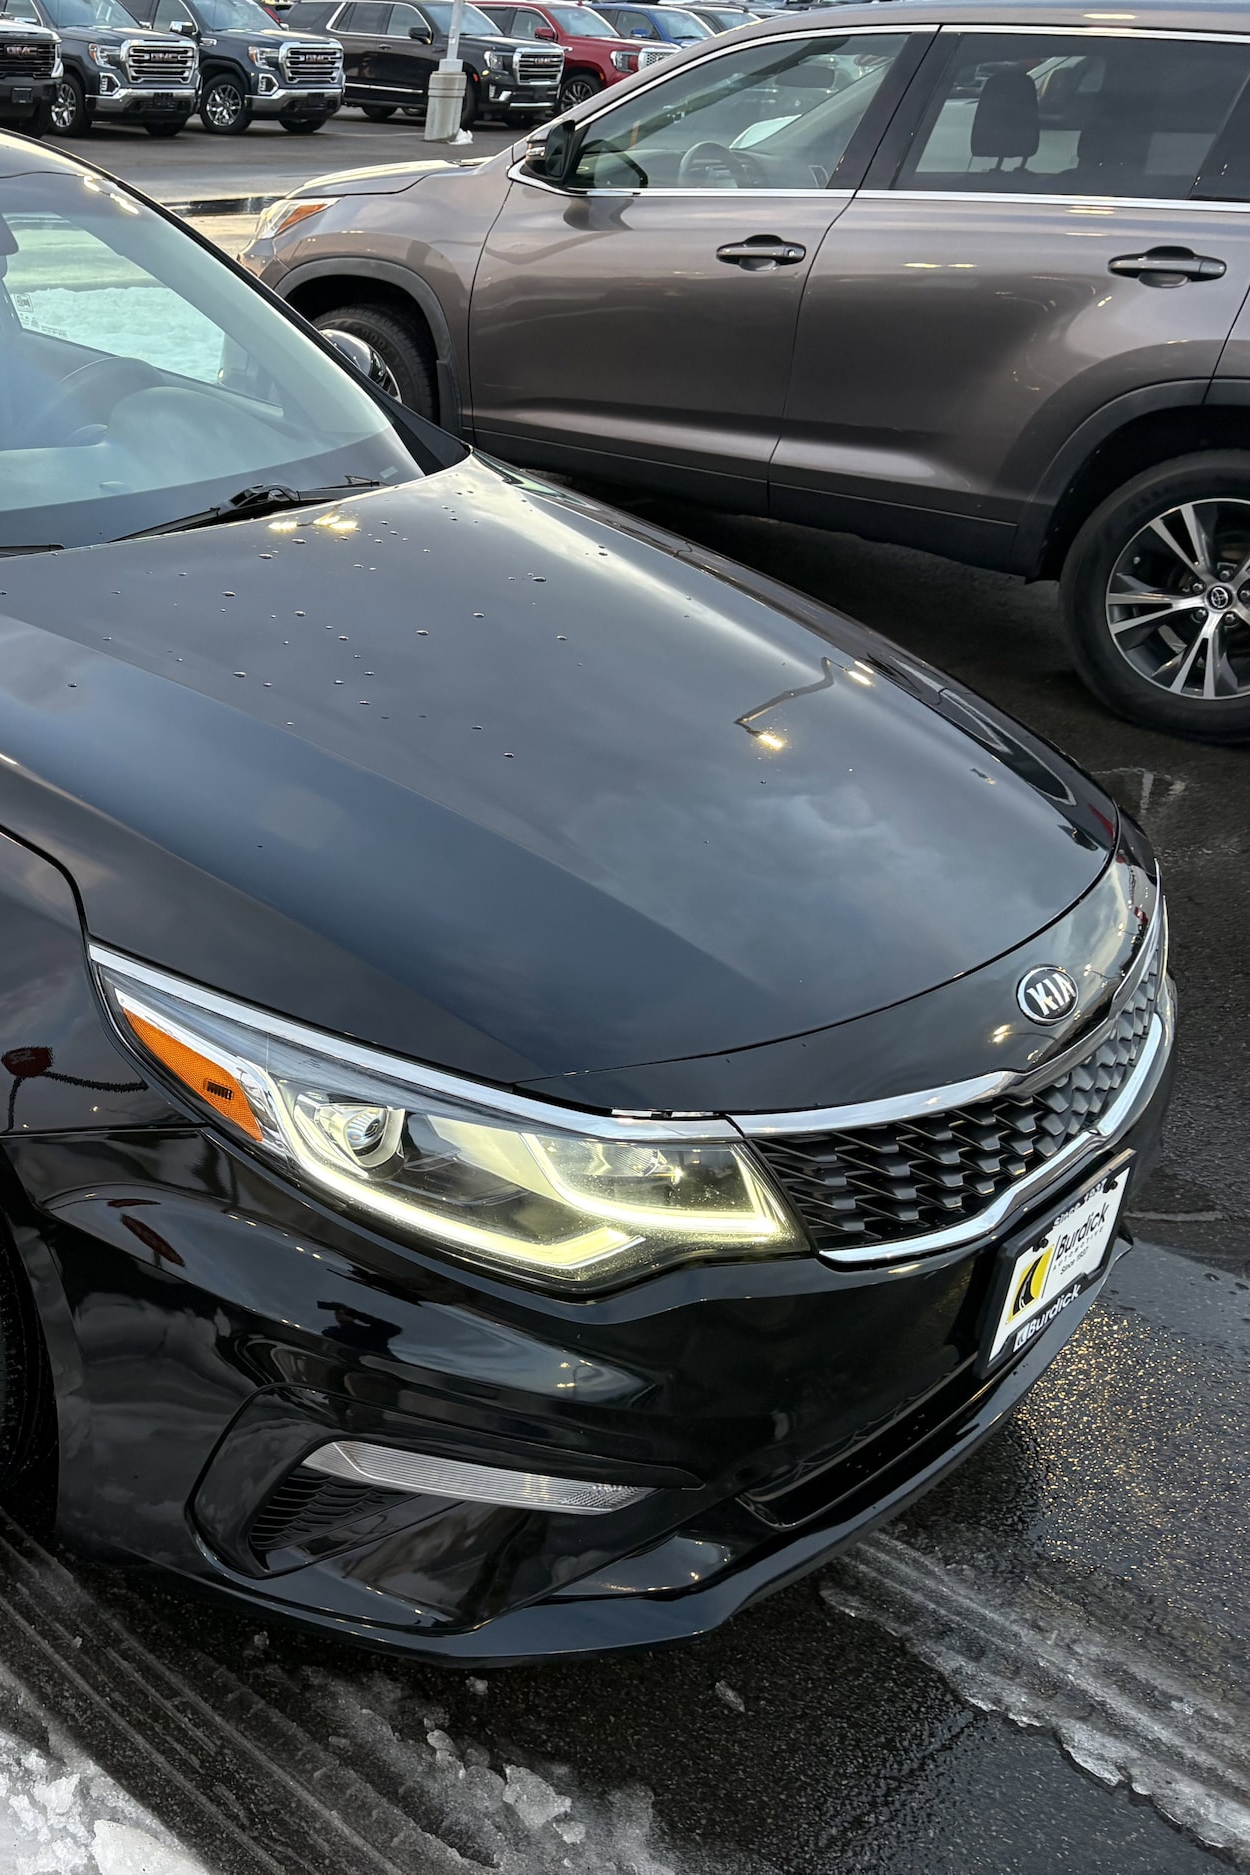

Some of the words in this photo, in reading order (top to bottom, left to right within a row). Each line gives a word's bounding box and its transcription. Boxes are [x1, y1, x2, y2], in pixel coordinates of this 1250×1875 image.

[6, 46, 37, 56] GMC
[150, 52, 178, 61] GMC
[305, 54, 330, 63] GMC
[1026, 972, 1077, 1017] KIA
[1055, 1201, 1110, 1261] Burdick
[1027, 1284, 1082, 1340] Burdick
